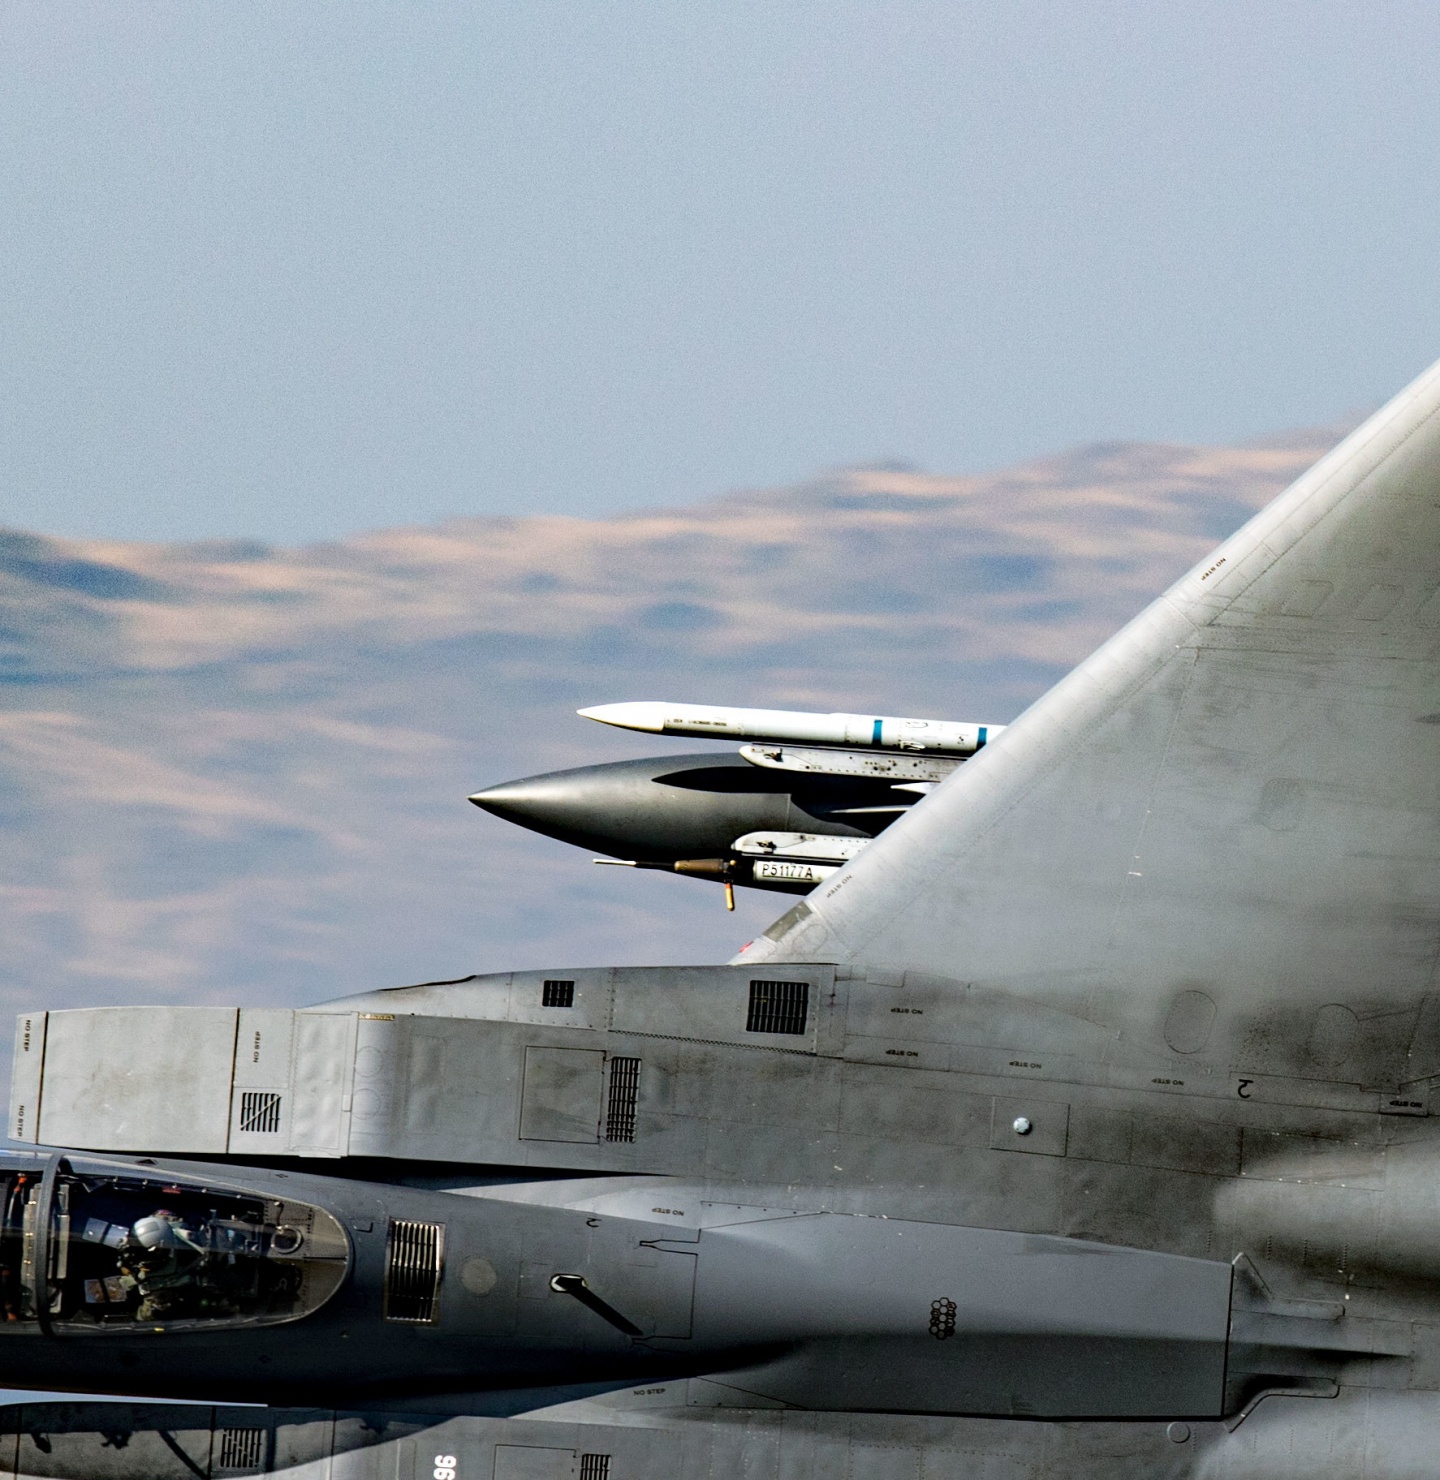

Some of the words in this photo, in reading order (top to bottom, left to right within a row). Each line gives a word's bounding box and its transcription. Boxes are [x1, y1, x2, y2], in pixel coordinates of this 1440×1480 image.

[1216, 558, 1226, 567] NO
[1202, 566, 1216, 581] STEP
[762, 864, 813, 878] P51177A
[842, 875, 852, 885] NO
[827, 884, 841, 898] STEP
[25, 1020, 31, 1031] NO
[253, 1052, 259, 1063] NO
[18, 1105, 25, 1117] NO
